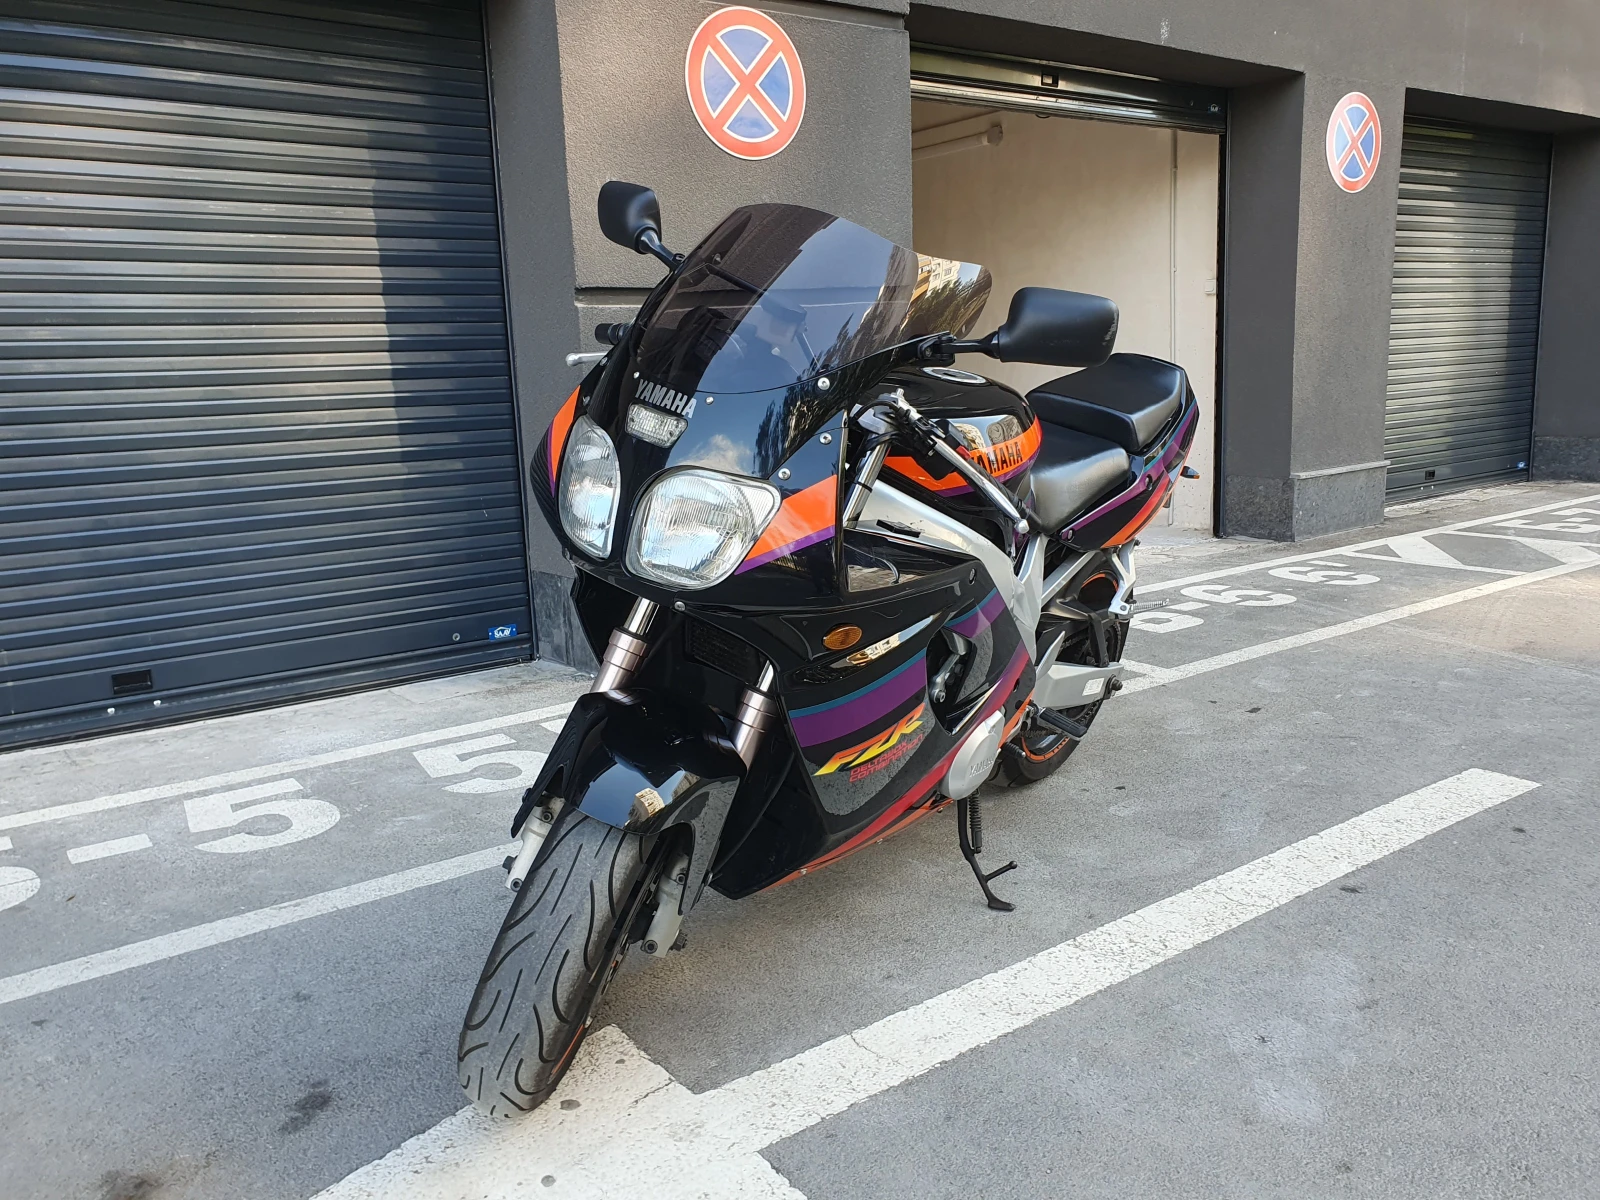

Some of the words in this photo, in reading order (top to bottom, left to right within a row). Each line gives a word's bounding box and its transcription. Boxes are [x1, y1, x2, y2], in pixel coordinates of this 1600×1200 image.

[635, 379, 697, 418] YAMAHA
[971, 442, 1023, 475] AMAHA
[812, 702, 926, 777] FZR
